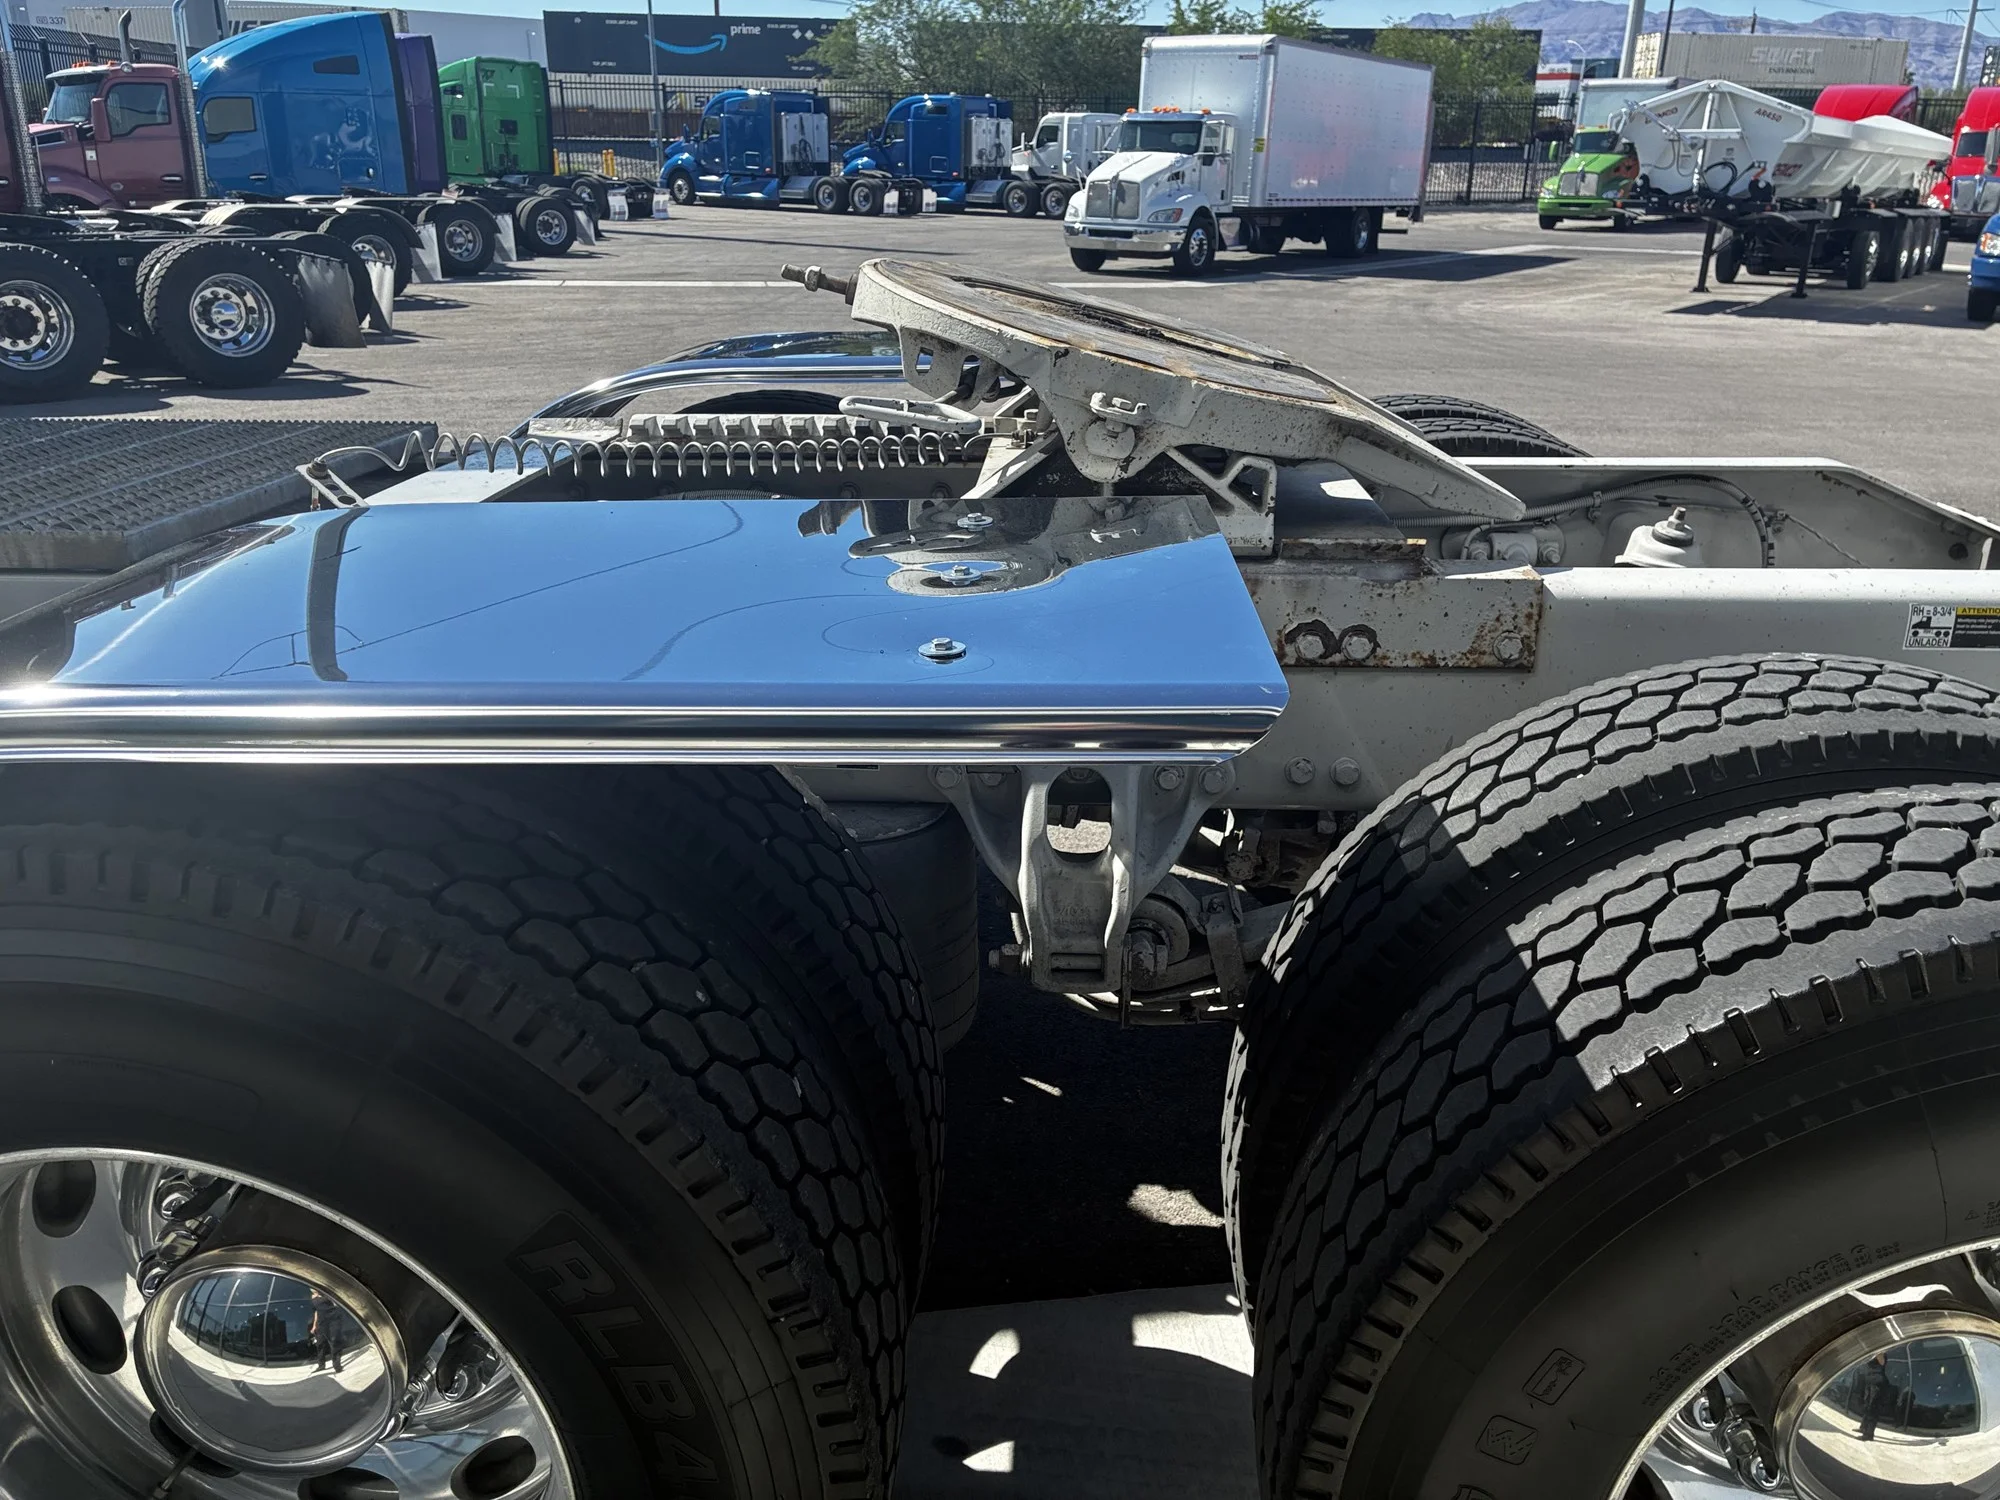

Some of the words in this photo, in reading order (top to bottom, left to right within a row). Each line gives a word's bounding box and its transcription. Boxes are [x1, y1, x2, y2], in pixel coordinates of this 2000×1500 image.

[729, 23, 762, 37] prime
[1749, 46, 1824, 66] SWIFT
[1912, 606, 1925, 616] RH
[1908, 637, 1949, 647] UNLADEN
[1709, 1295, 1765, 1332] LOAD
[1768, 1252, 1845, 1296] RANGE
[516, 1240, 720, 1499] RLB4
